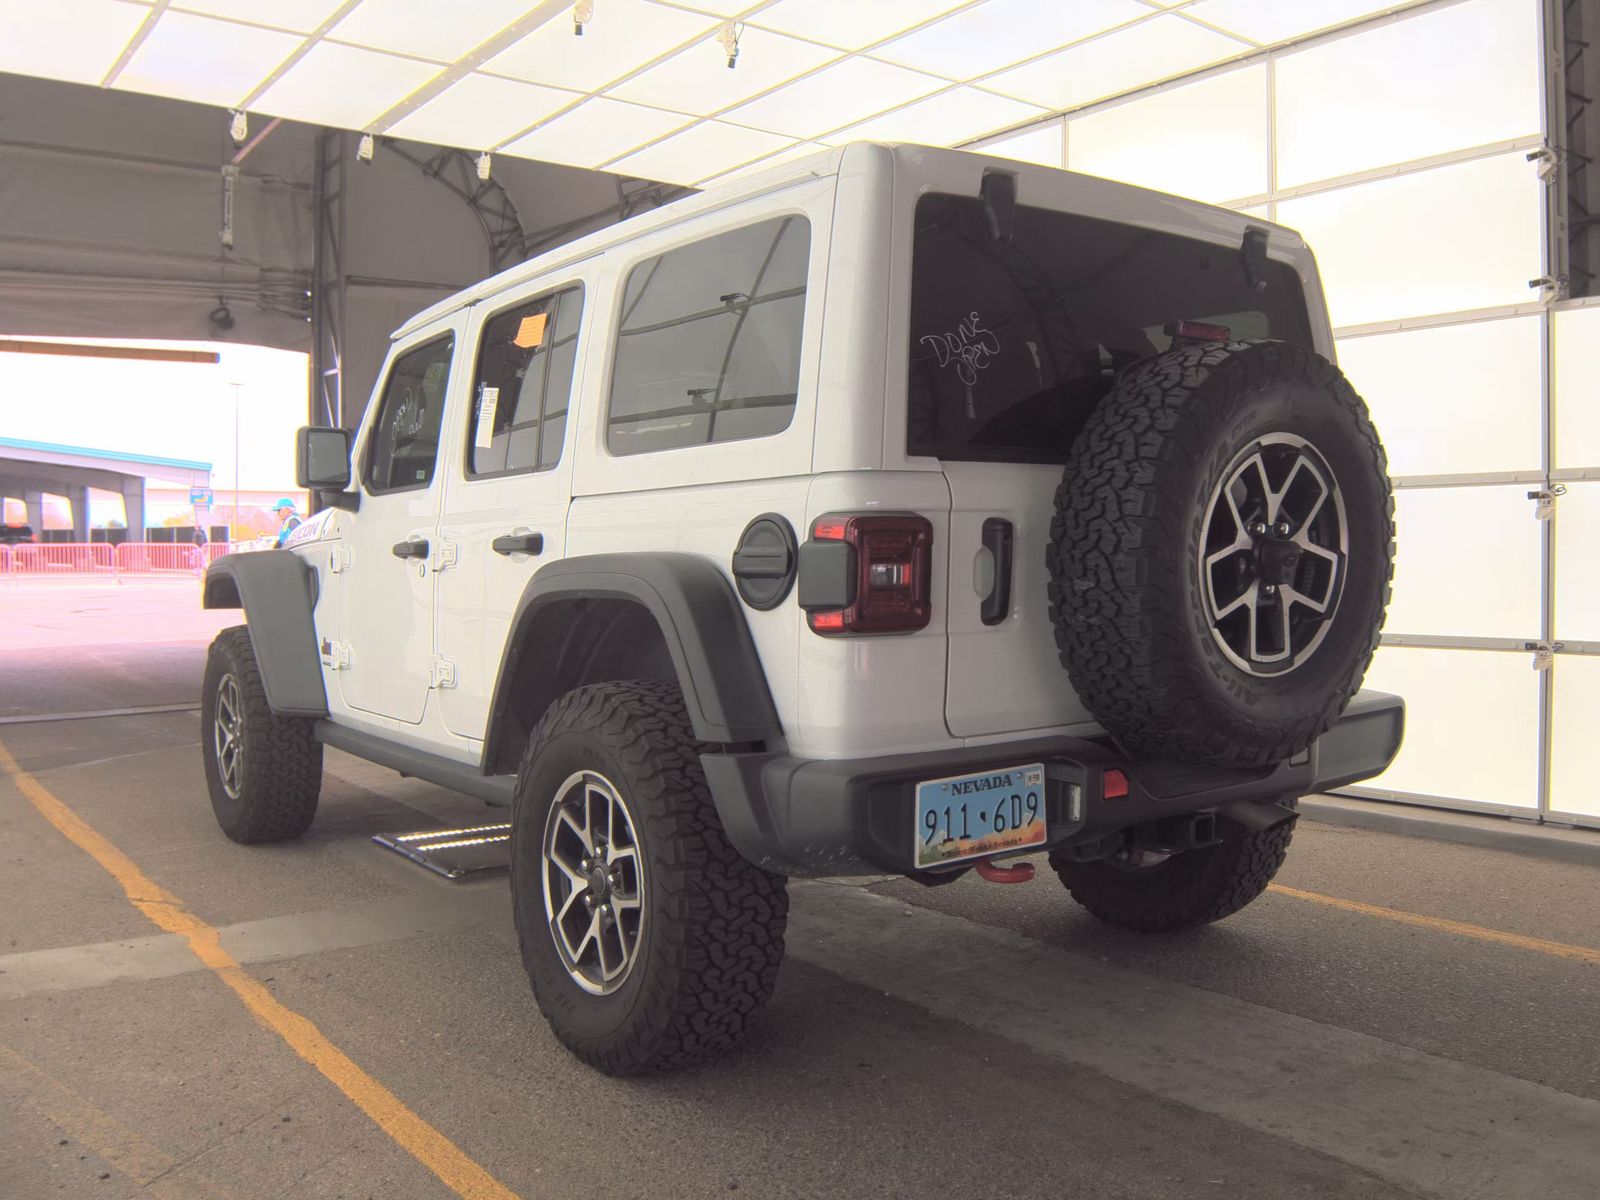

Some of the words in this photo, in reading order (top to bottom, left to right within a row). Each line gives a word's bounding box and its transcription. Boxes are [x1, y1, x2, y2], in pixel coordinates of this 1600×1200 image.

[919, 311, 988, 368] DONE
[951, 774, 1013, 796] NEVADA
[925, 803, 971, 846] 911
[994, 791, 1038, 833] 6D9
